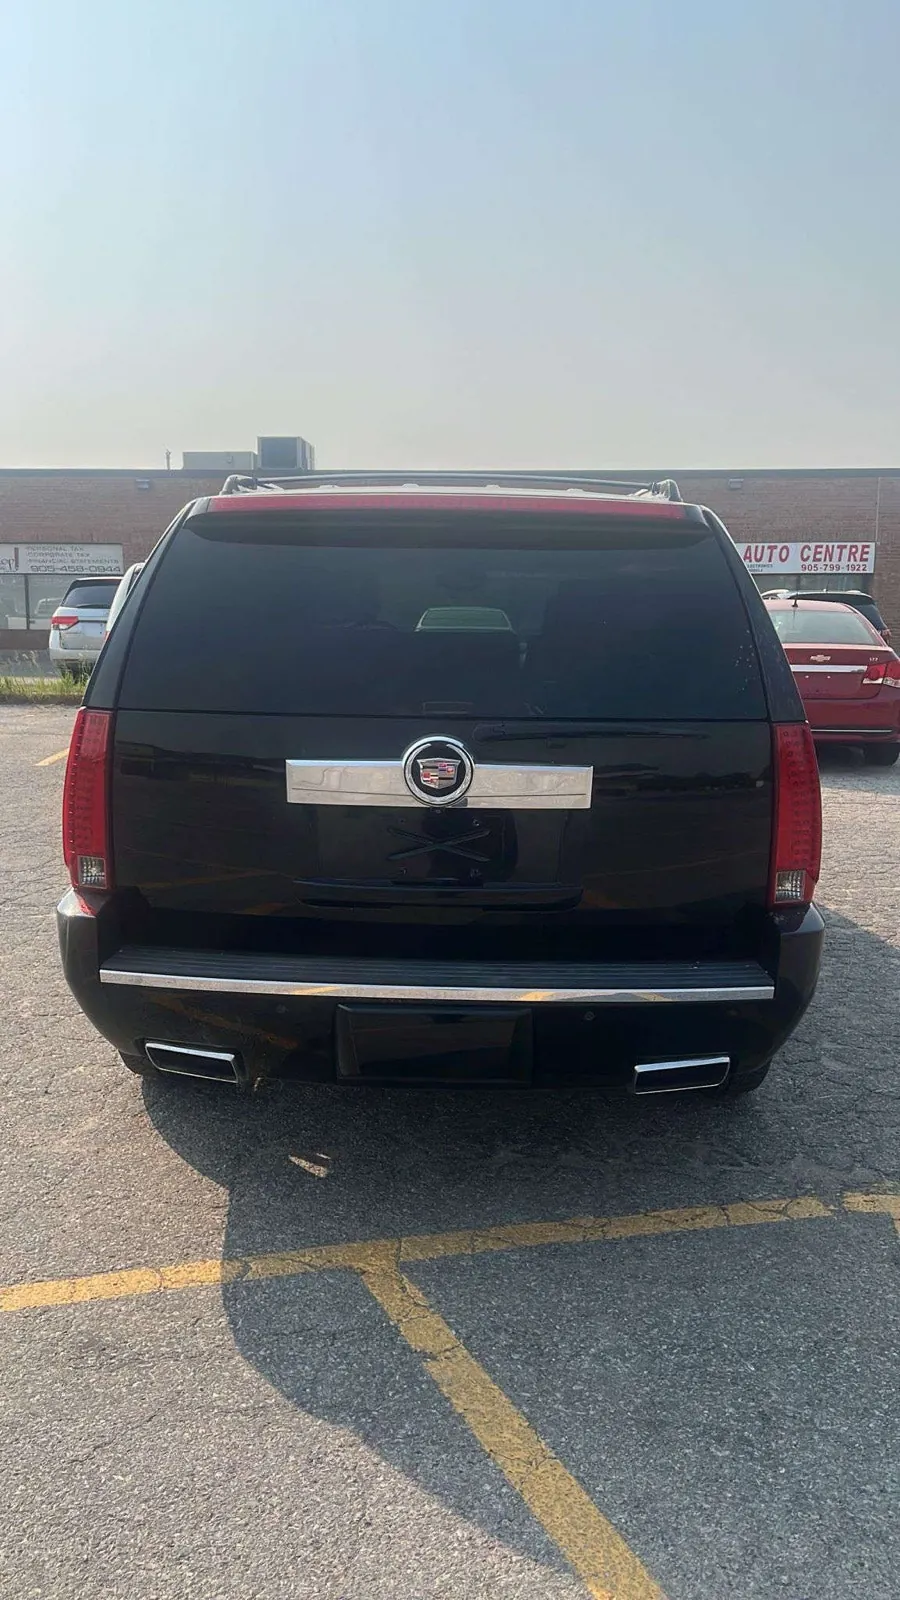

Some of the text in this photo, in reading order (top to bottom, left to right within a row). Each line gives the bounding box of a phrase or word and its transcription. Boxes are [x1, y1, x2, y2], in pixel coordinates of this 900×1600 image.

[743, 544, 871, 563] AUTO CENTRE
[30, 565, 121, 573] 905-458-0944
[801, 563, 868, 572] 905-799-1922
